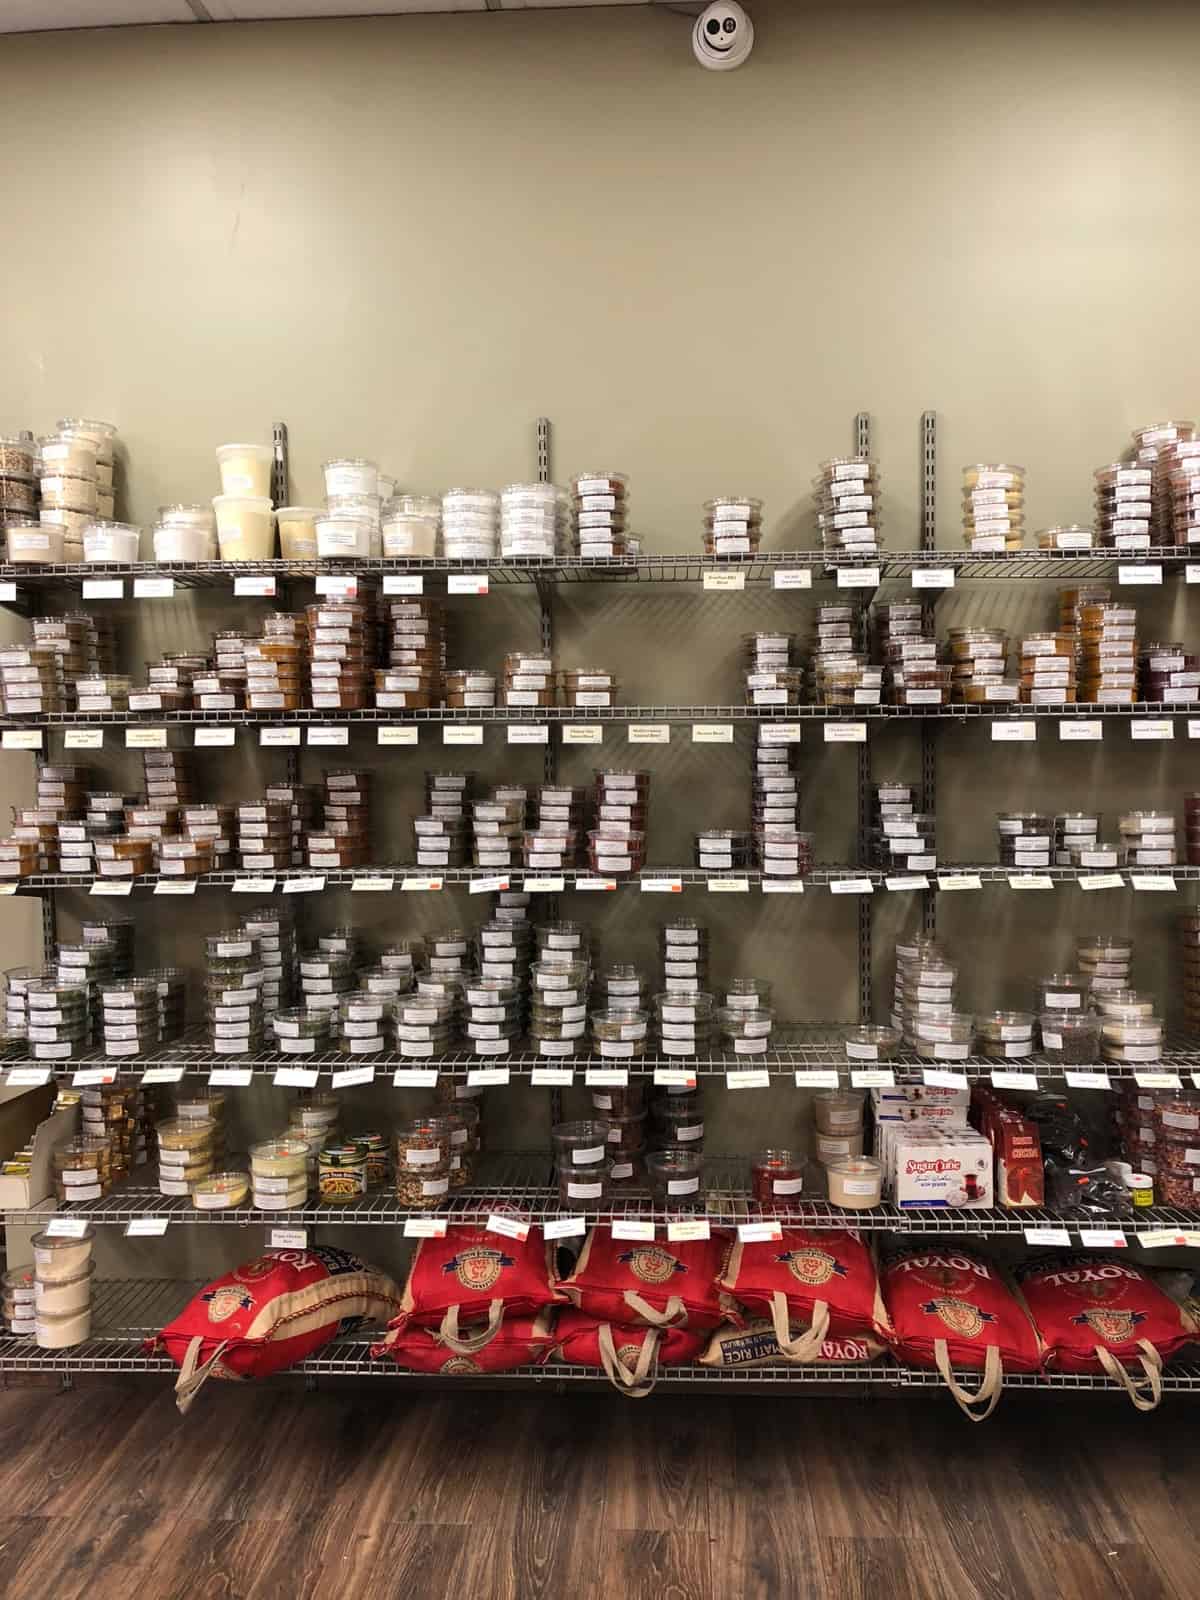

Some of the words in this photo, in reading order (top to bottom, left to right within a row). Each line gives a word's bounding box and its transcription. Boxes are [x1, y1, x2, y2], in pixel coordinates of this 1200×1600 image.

[471, 1266, 488, 1280] 25
[896, 1255, 991, 1281] ROYAL
[1043, 1264, 1143, 1288] ROYAL
[724, 1346, 752, 1364] RICE
[753, 1342, 783, 1358] MATI
[818, 1339, 870, 1360] ROYA
